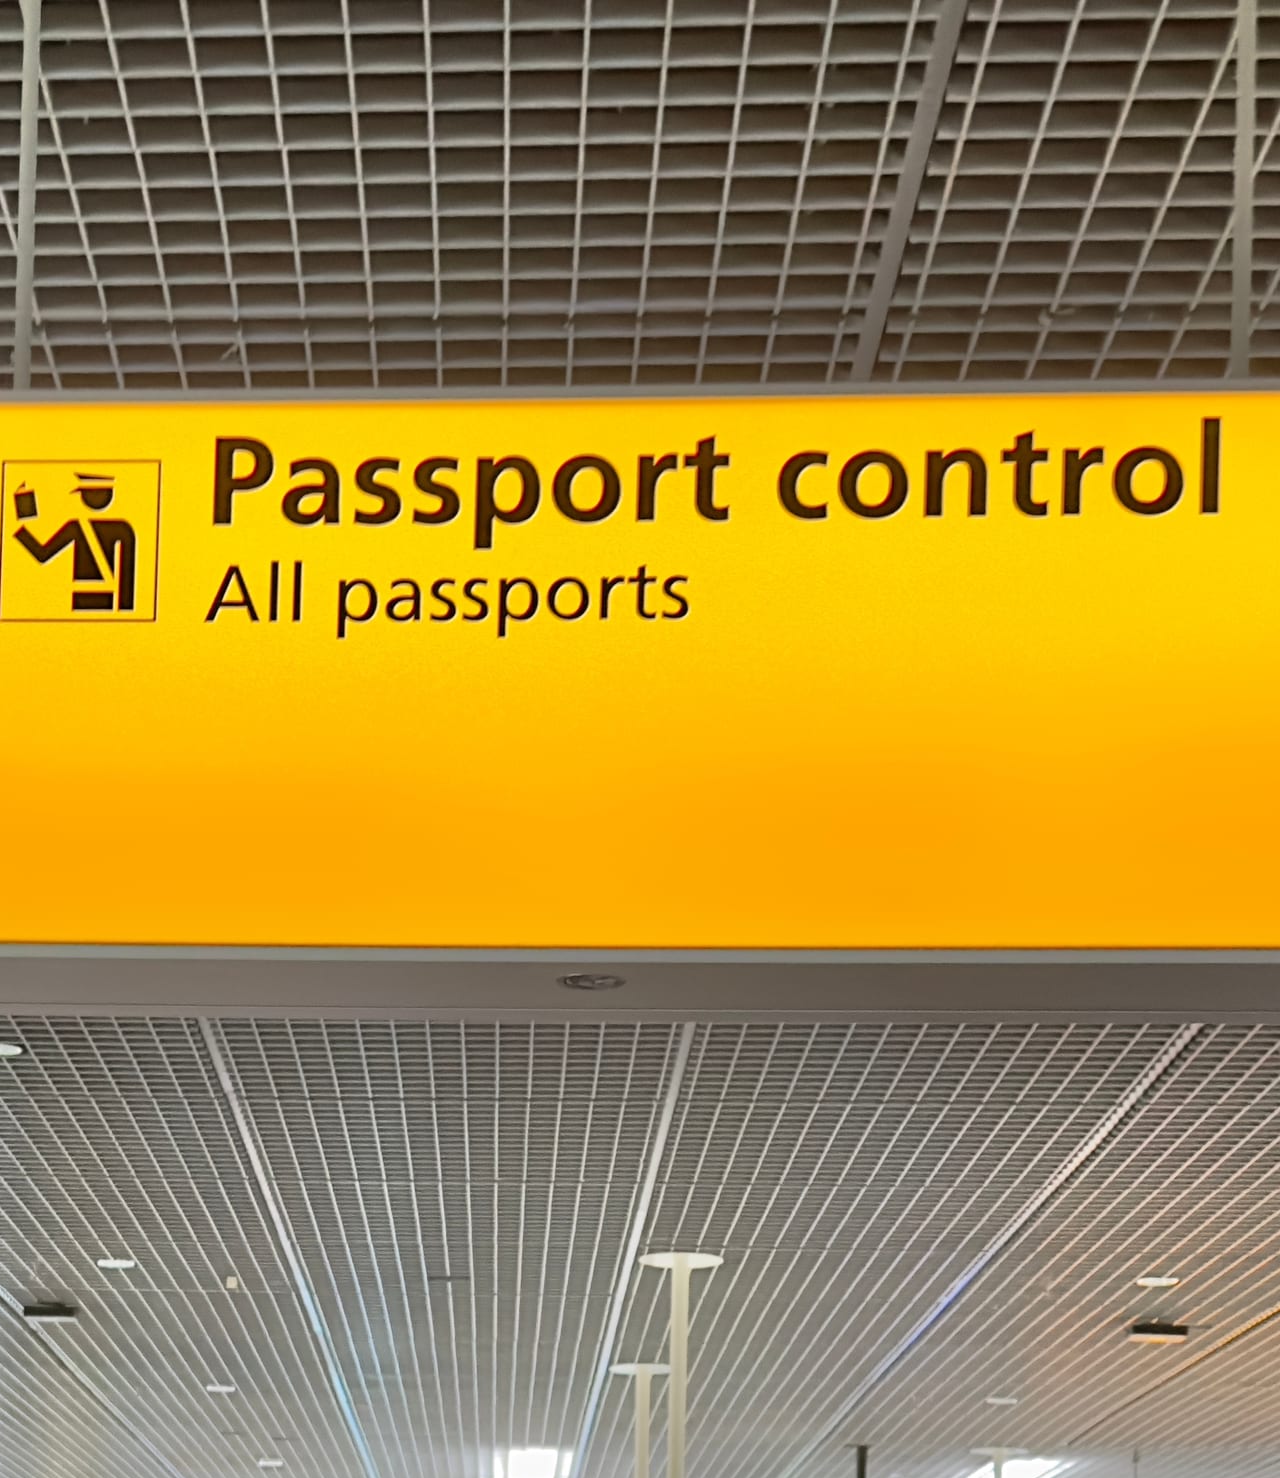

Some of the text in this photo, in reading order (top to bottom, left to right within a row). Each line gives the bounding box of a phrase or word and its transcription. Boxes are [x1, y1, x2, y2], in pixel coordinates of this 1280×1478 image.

[213, 418, 1221, 549] Passport control
[205, 561, 689, 639] All passports
